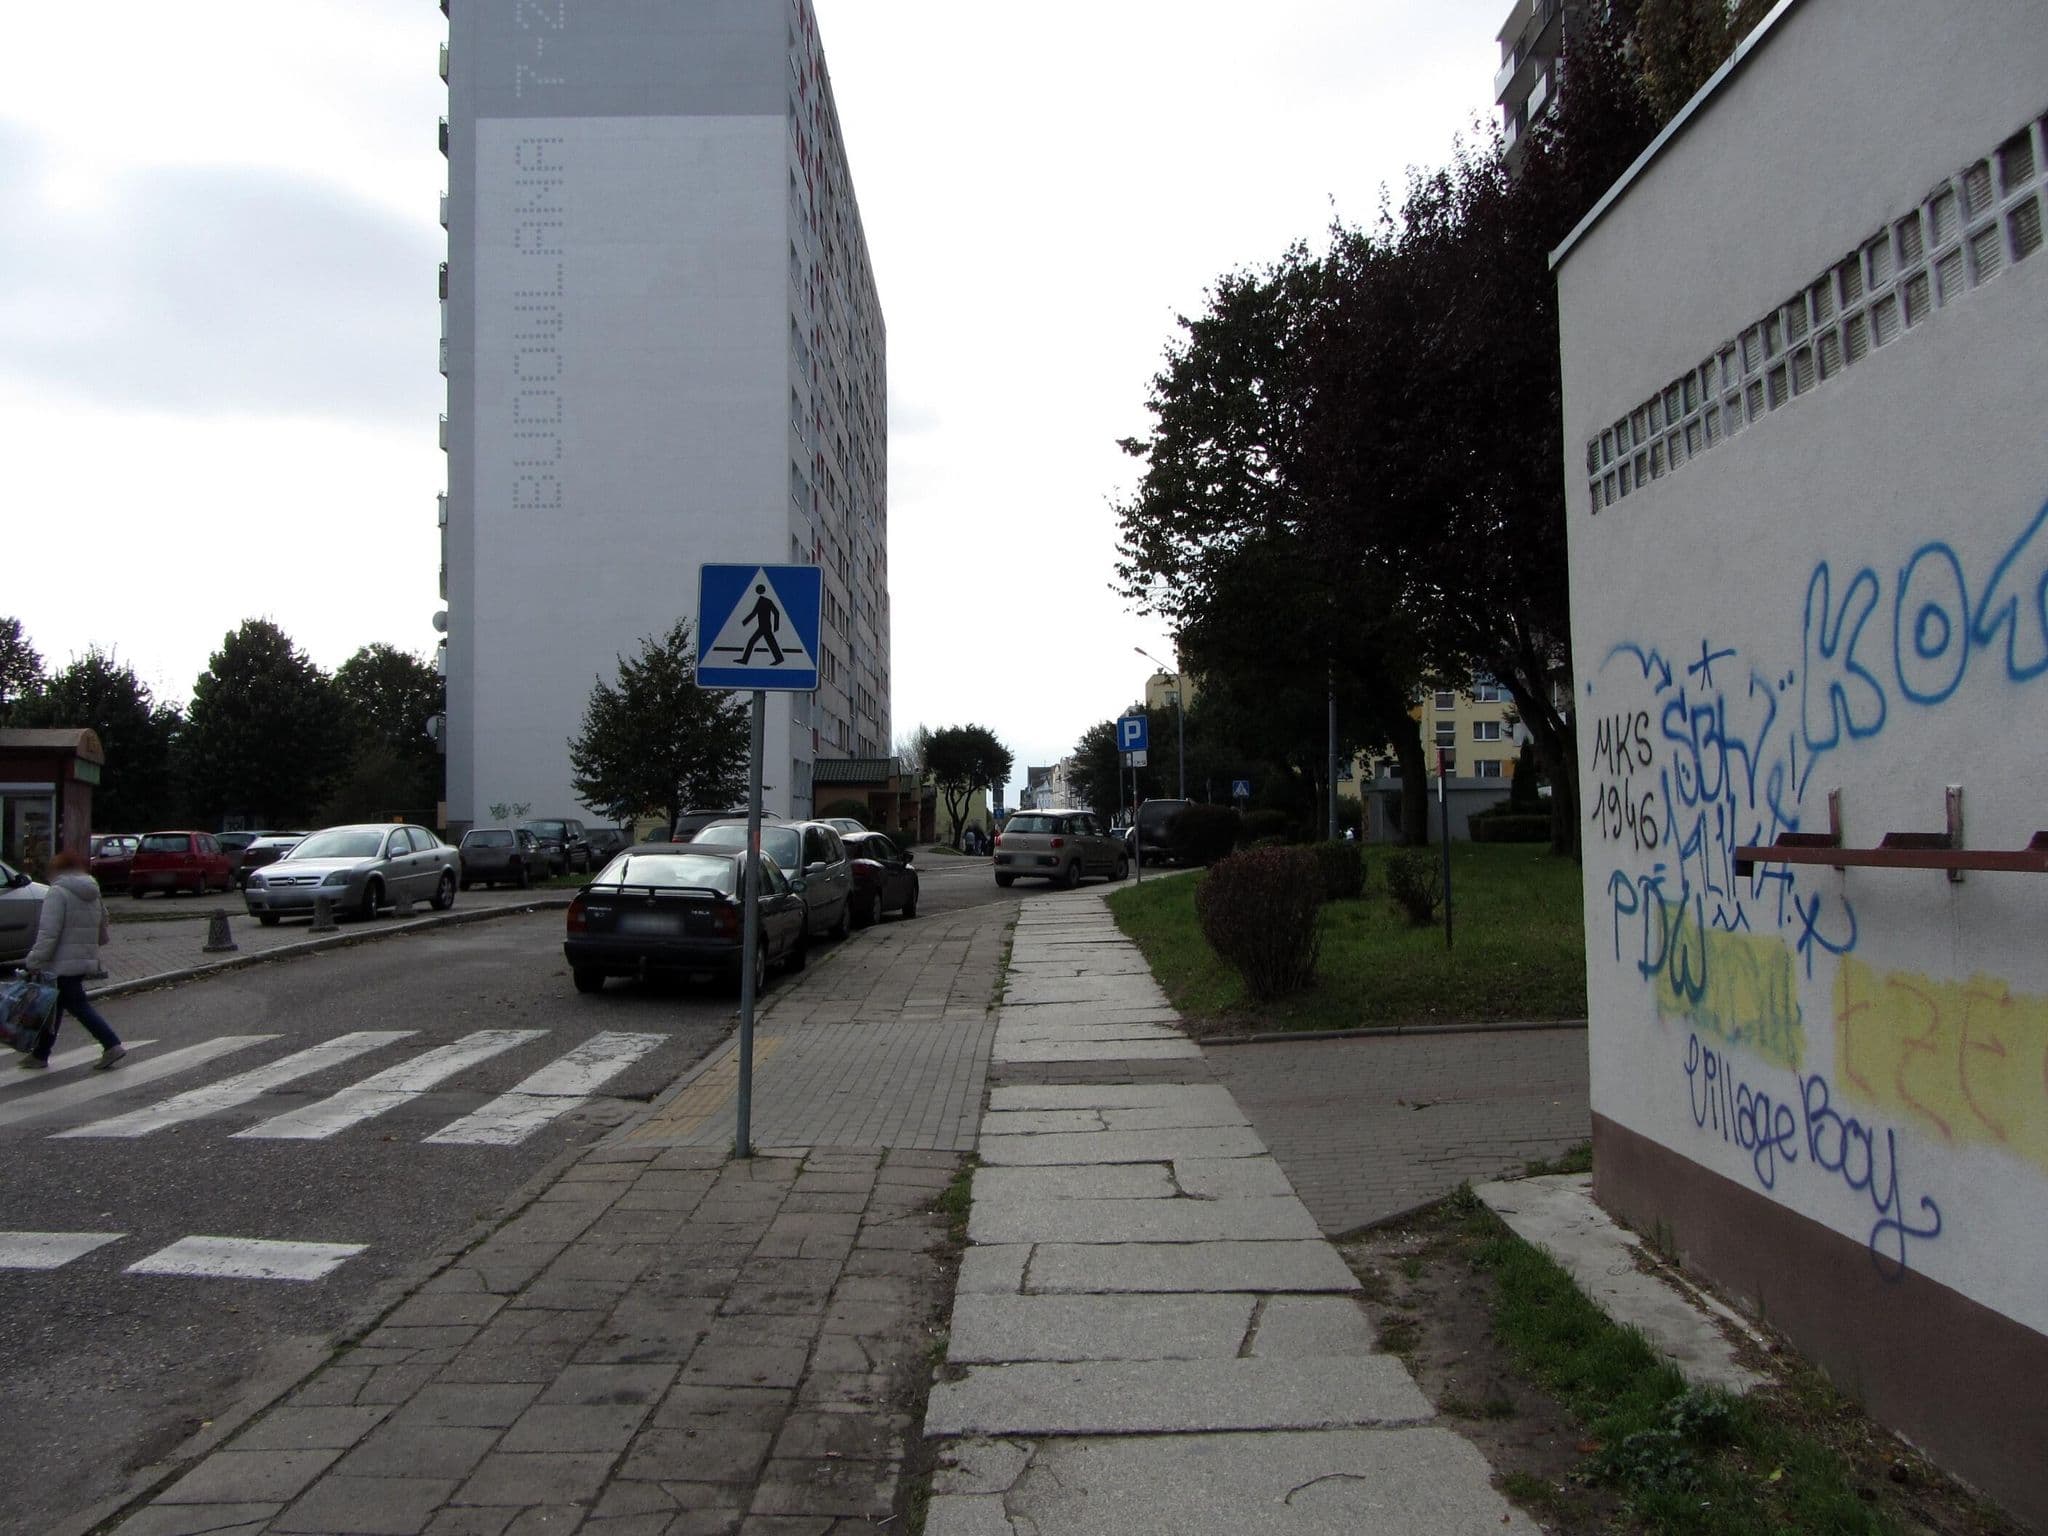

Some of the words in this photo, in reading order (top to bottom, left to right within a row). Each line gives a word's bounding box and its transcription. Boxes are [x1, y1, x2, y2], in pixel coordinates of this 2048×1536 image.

[512, 137, 565, 509] BUDOWLANA
[1124, 720, 1142, 747] P
[1592, 711, 1653, 776] MKS
[1592, 778, 1660, 852] 1946
